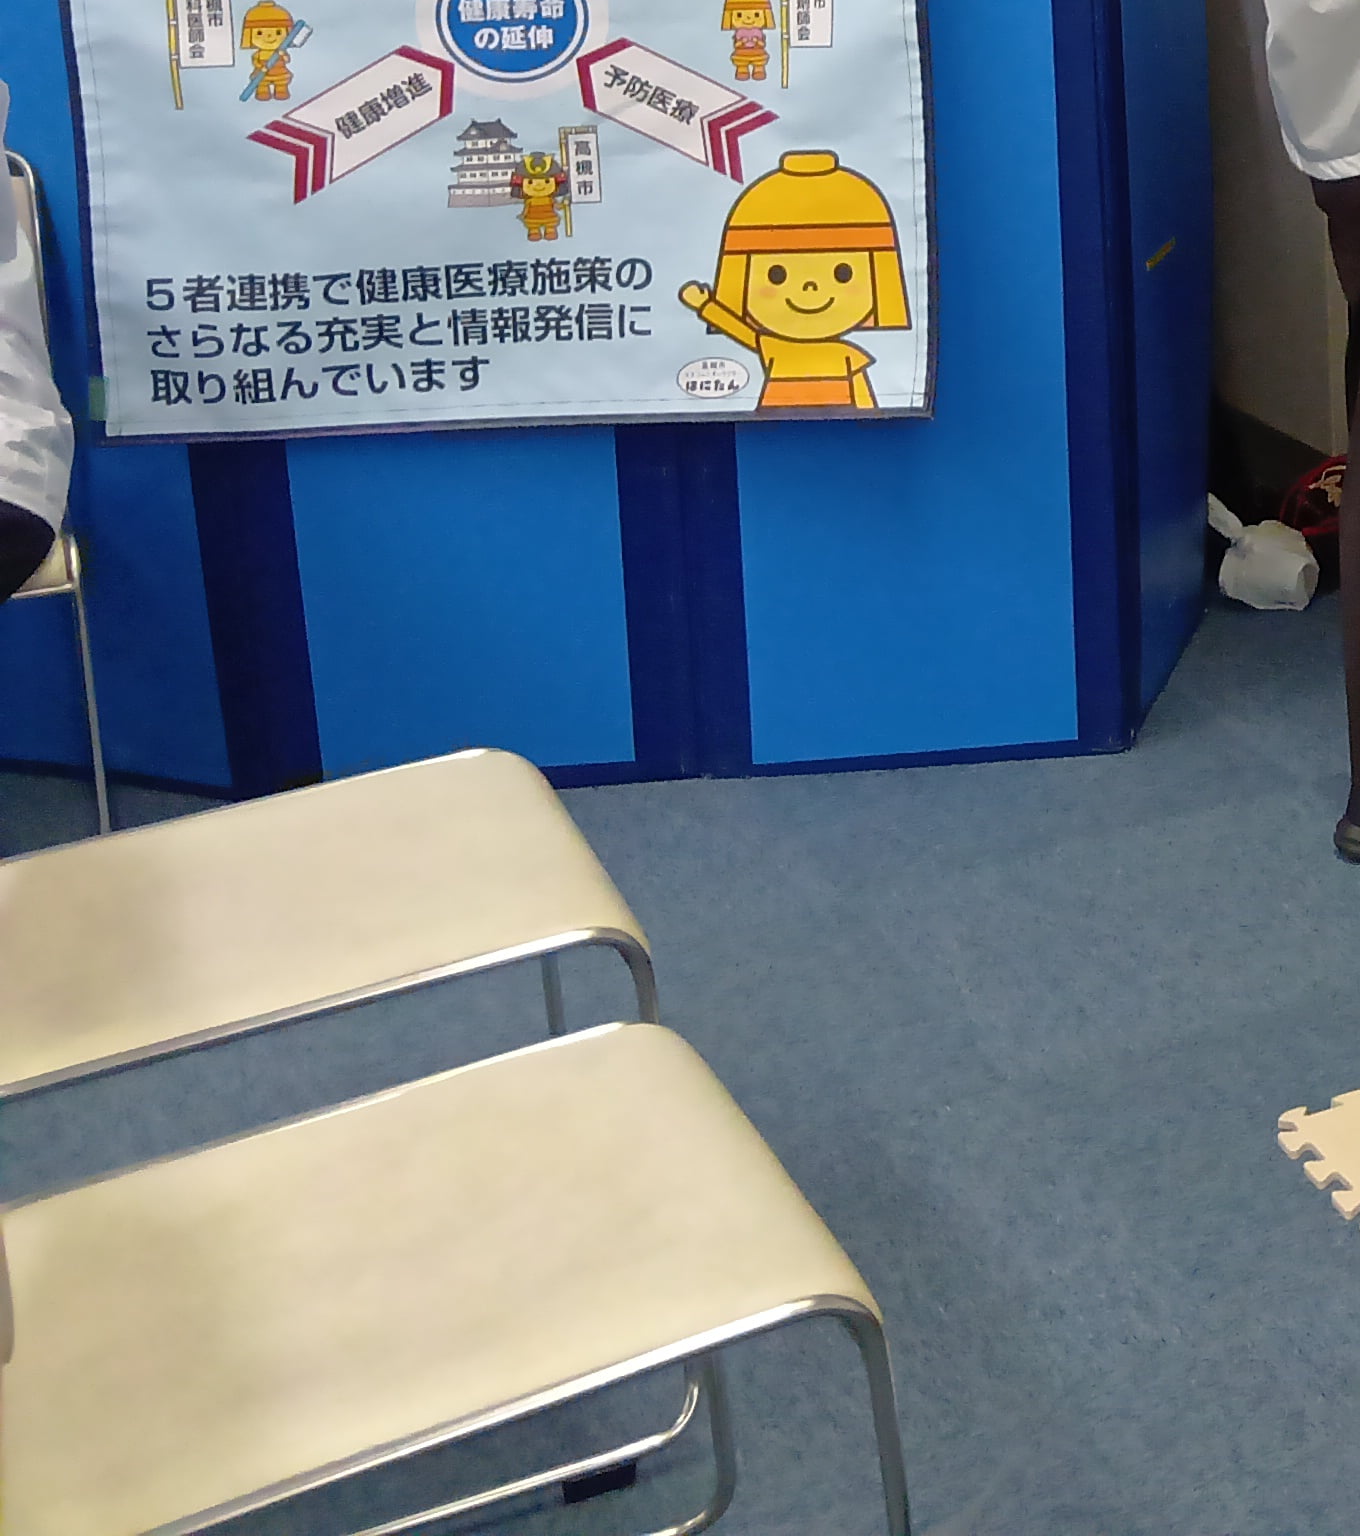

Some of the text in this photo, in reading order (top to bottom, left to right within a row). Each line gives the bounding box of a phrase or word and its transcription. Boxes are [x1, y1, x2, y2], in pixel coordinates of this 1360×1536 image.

[473, 25, 555, 51] の延伸
[334, 71, 433, 140] 健康増進
[603, 63, 701, 126] 予防医療
[574, 140, 594, 197] 高槻市
[146, 256, 654, 314] 5者連携で健康医療施策の
[147, 303, 652, 359] さらなる充実と情報発信に
[151, 355, 490, 406] 取り組んでいます
